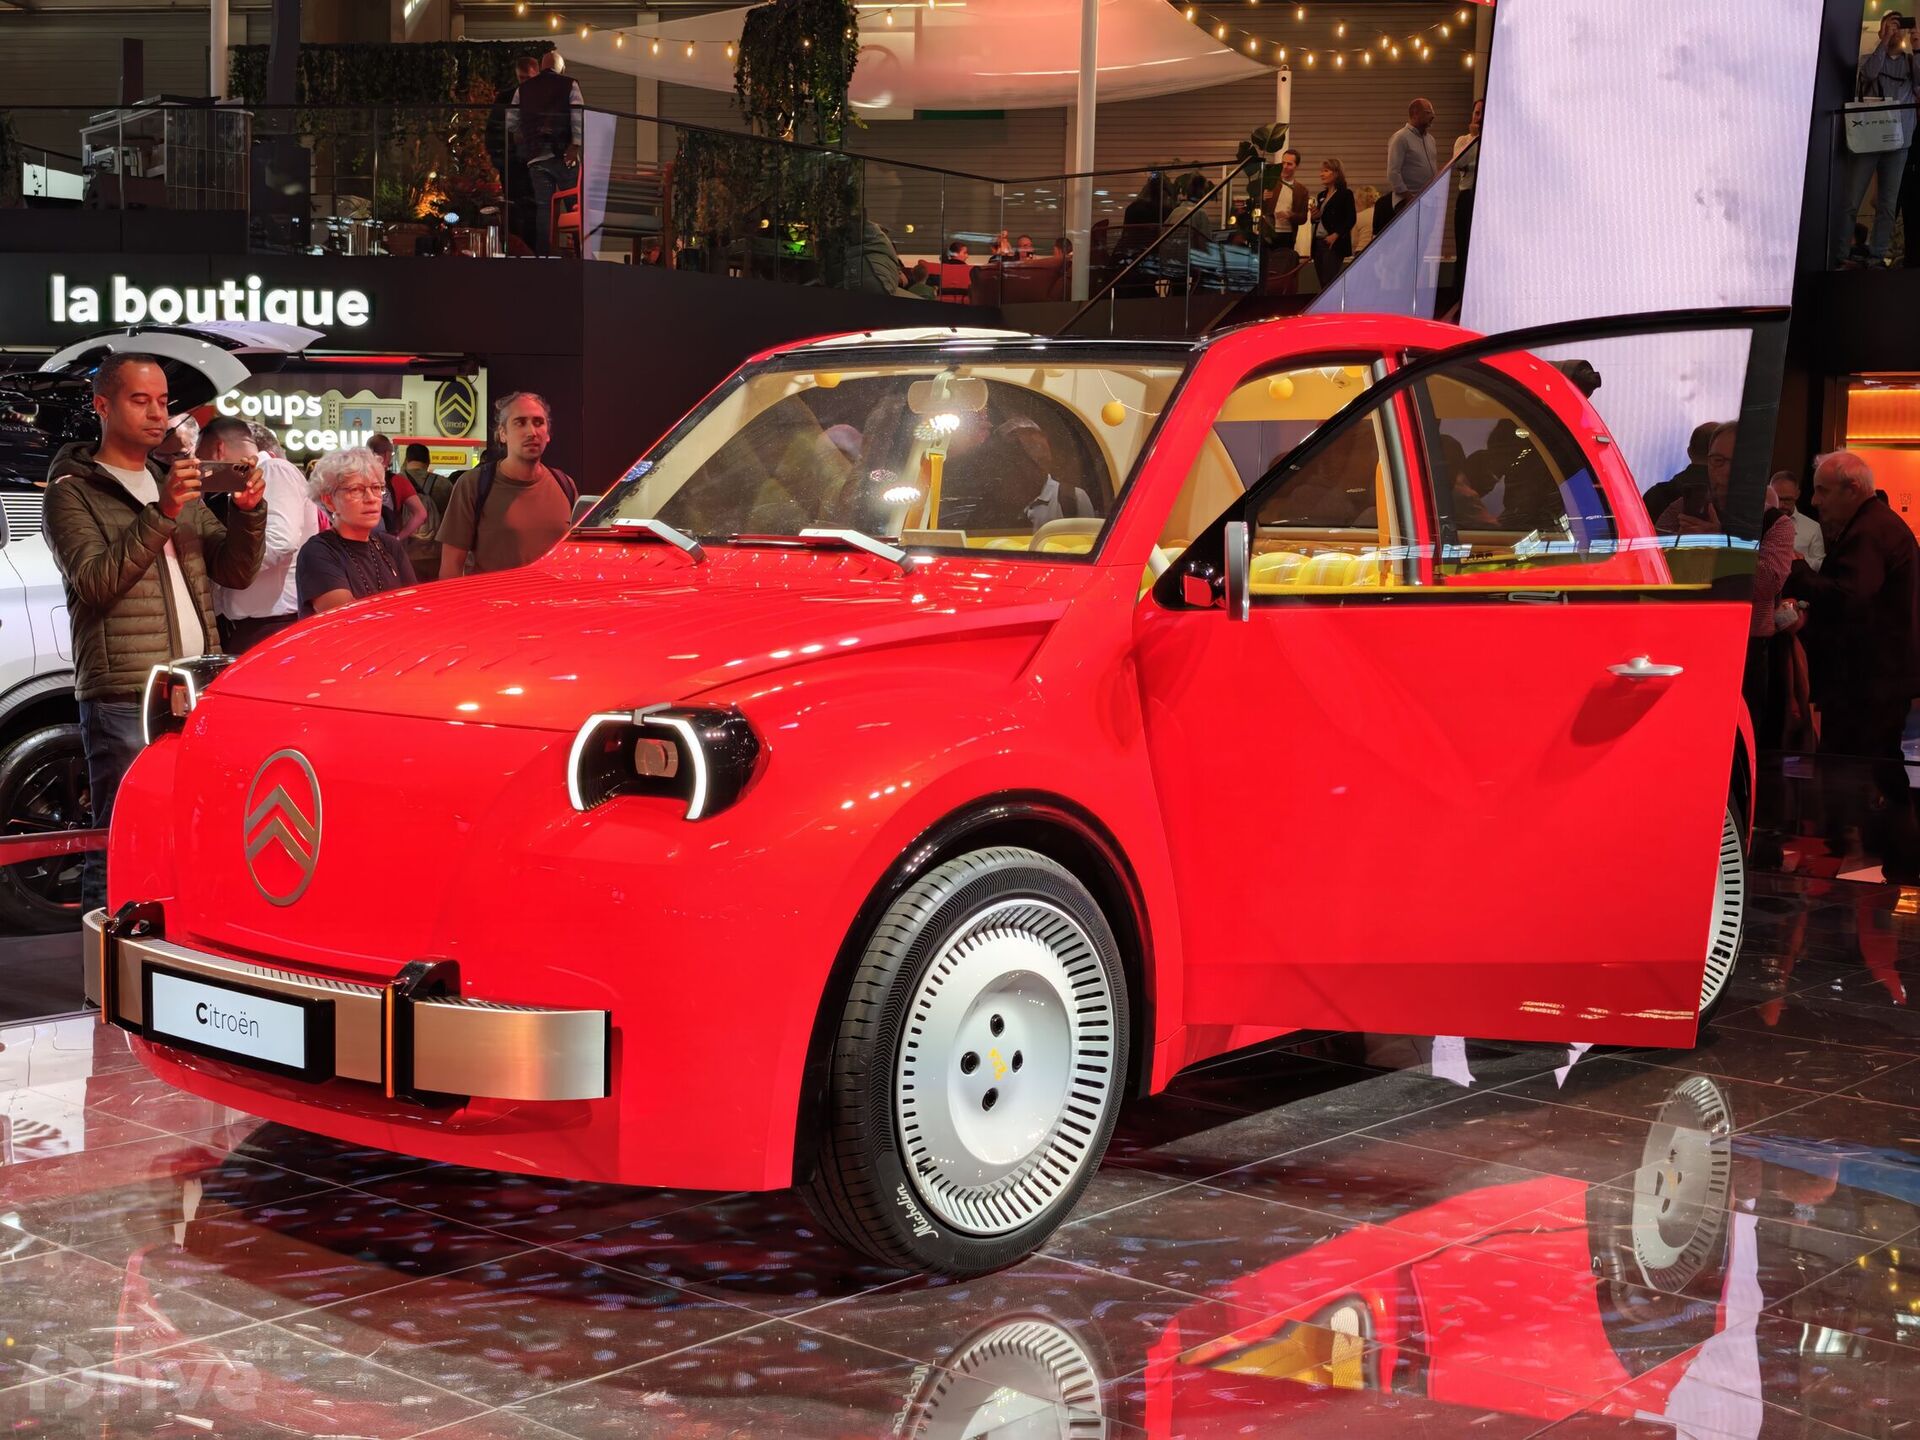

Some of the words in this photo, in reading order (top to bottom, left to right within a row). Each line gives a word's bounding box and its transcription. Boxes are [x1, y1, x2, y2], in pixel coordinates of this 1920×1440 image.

[52, 275, 98, 322] la
[112, 275, 369, 326] boutique
[216, 389, 322, 425] Coups
[376, 416, 396, 425] 2CV
[196, 1002, 259, 1038] Citroën
[897, 1182, 939, 1238] Michelin
